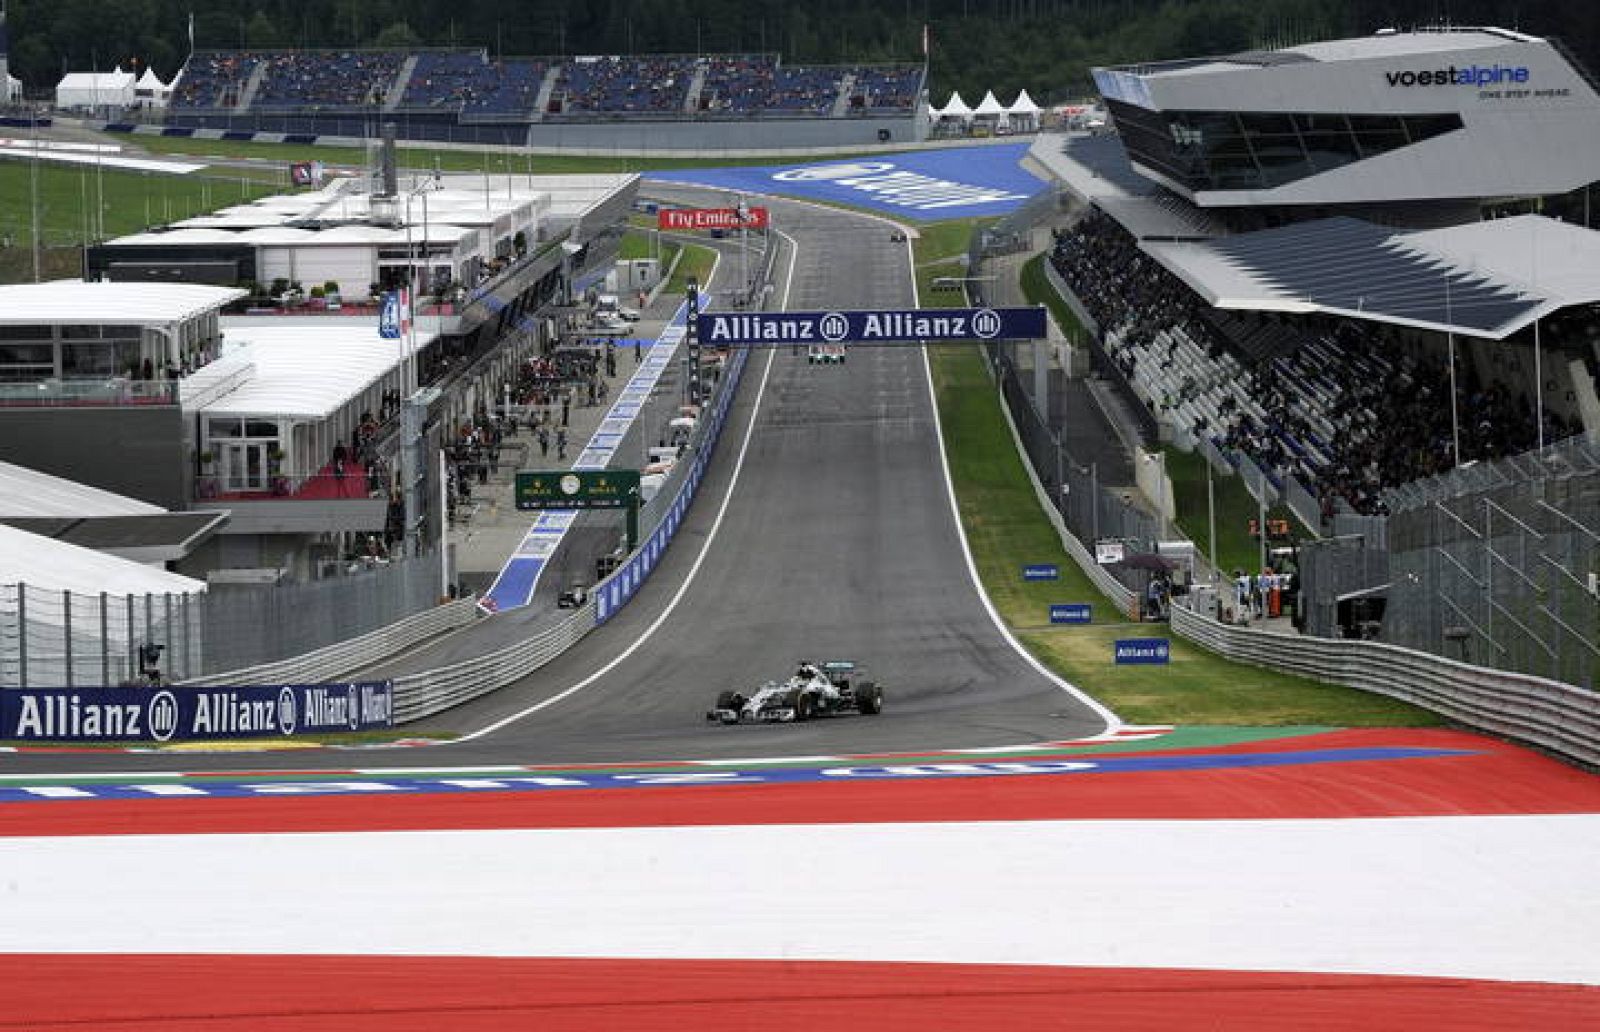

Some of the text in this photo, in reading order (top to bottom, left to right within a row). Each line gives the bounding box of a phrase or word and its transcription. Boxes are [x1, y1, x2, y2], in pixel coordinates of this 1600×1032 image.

[1386, 64, 1530, 87] voestalpine
[668, 211, 759, 228] Fly Emiras
[711, 313, 965, 340] Allianz Allianz
[17, 695, 141, 736] Allianz
[193, 693, 275, 732] Allianz
[304, 689, 348, 726] Allianz
